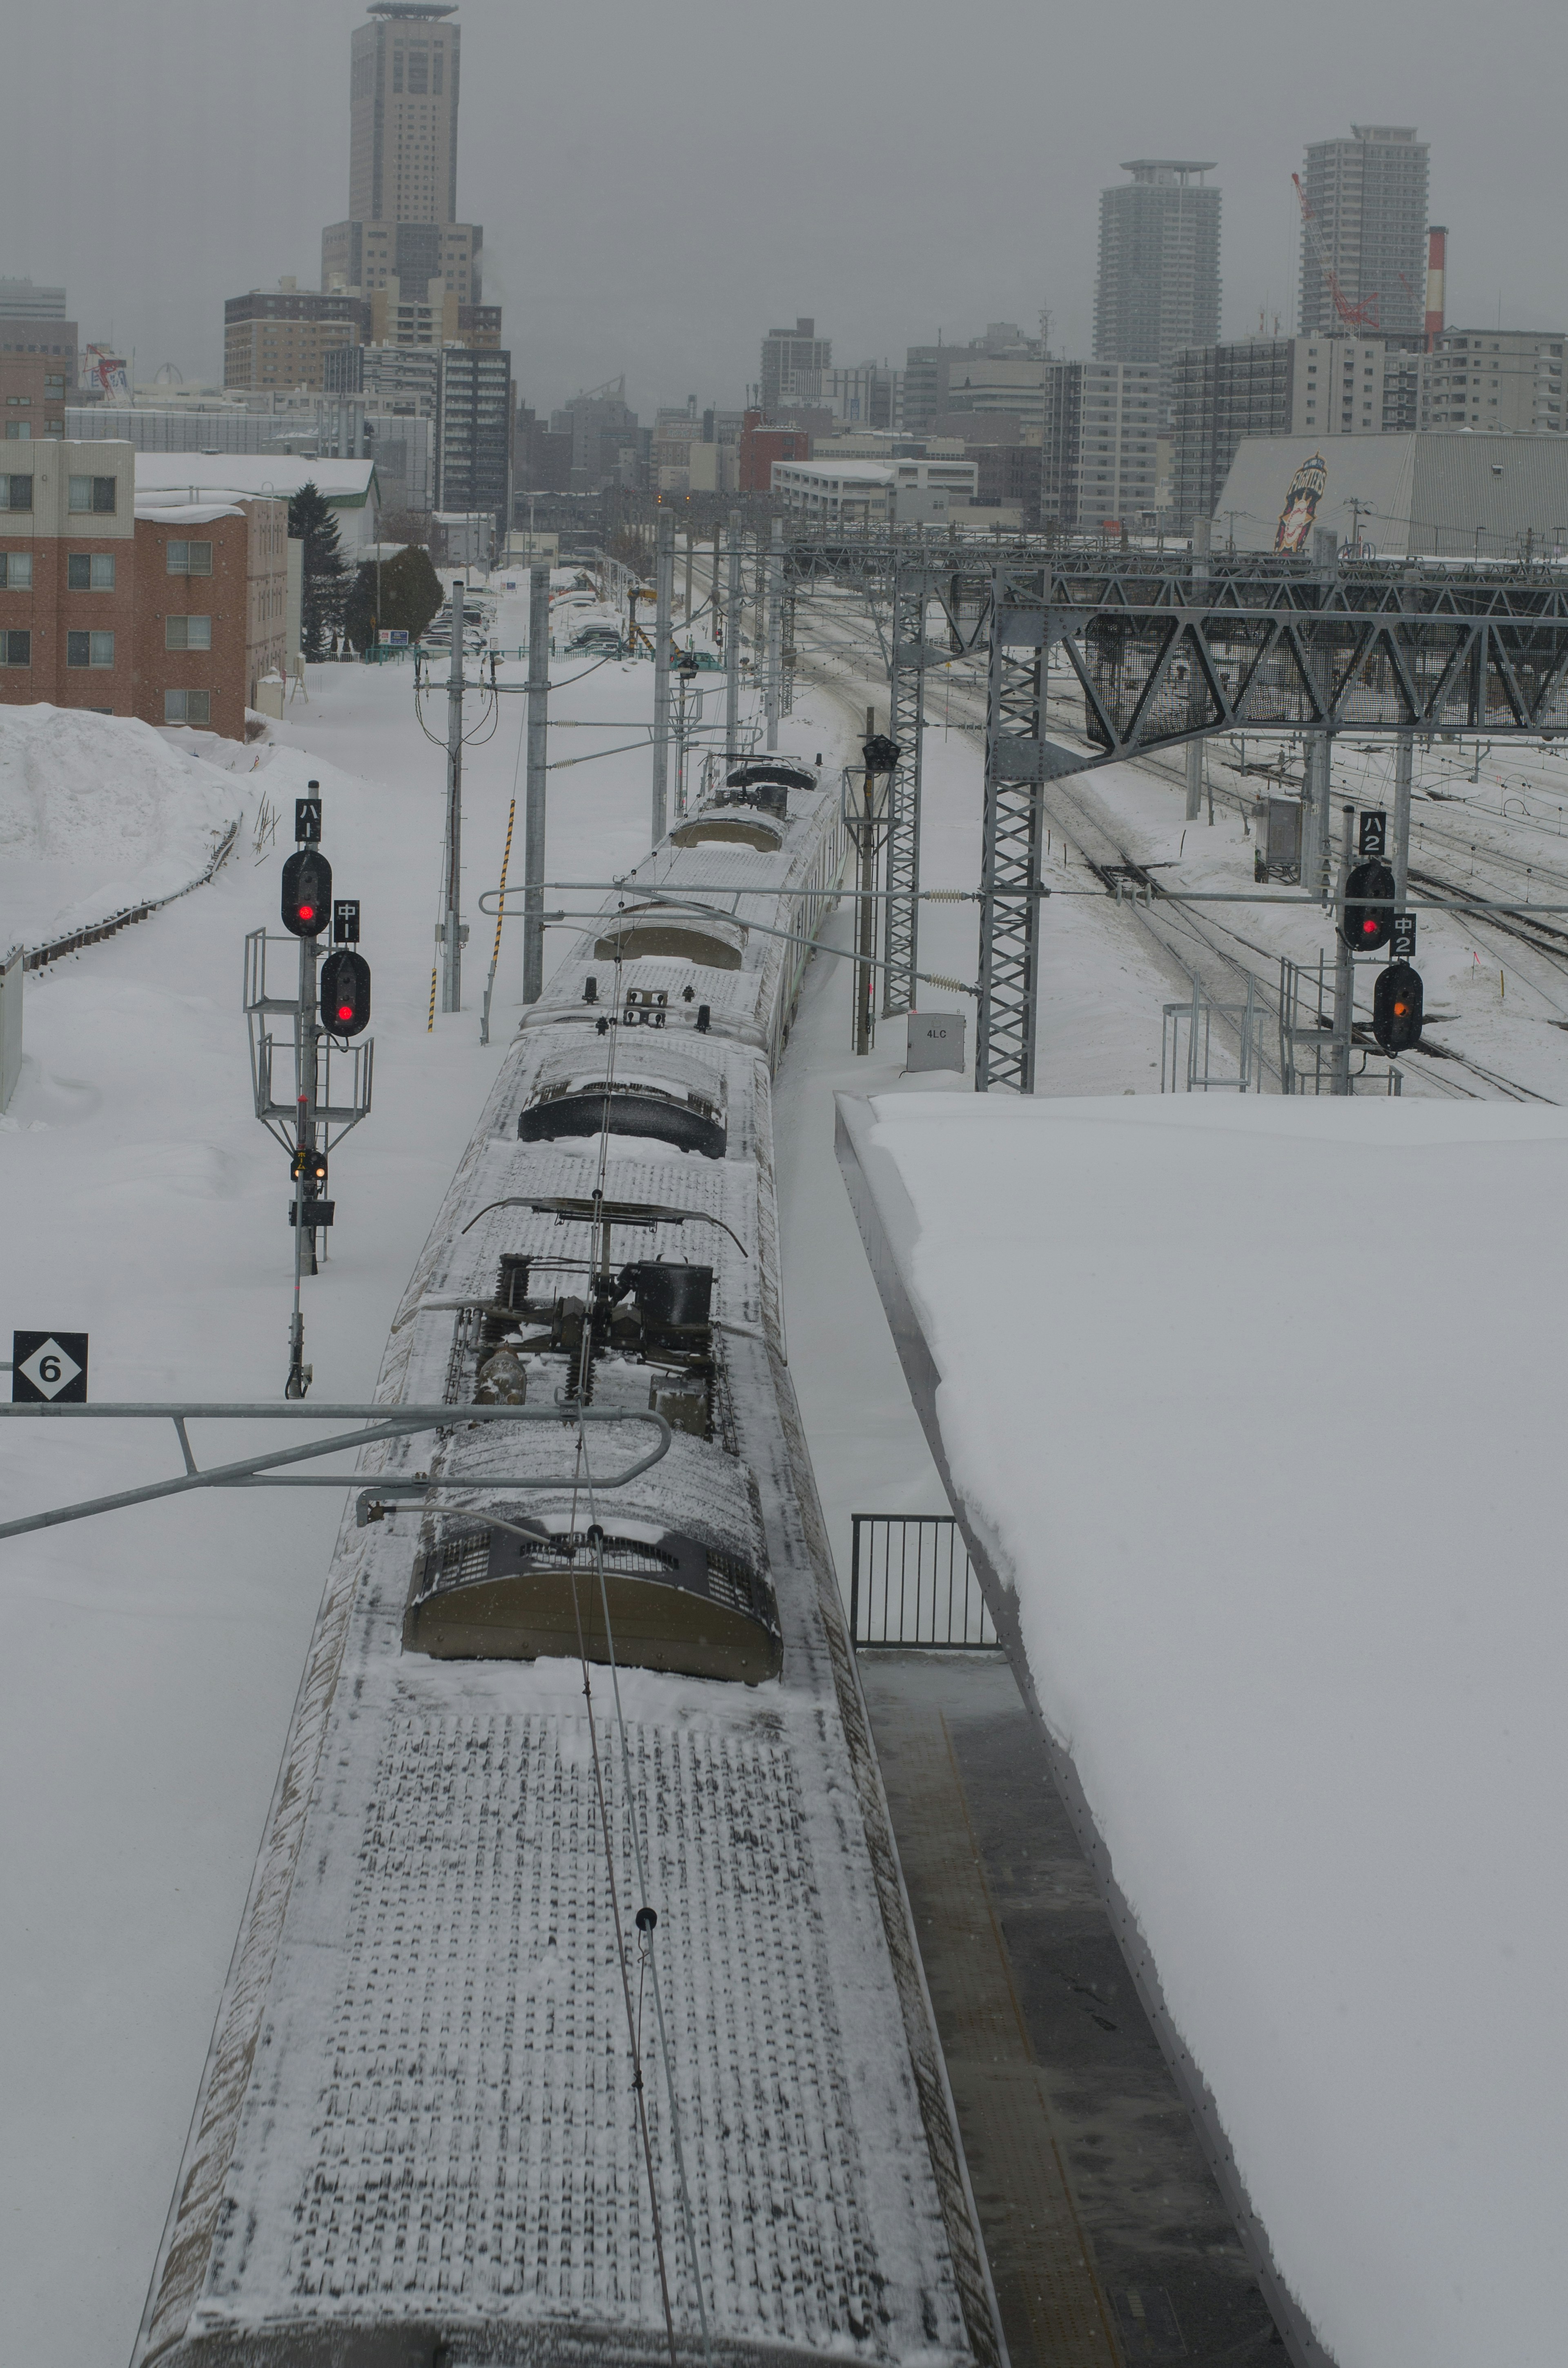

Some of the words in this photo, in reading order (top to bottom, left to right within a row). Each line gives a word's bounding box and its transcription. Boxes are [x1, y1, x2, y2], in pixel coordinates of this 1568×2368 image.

[667, 428, 689, 438] ホテル
[1288, 468, 1326, 495] FIGHTERS
[297, 1152, 305, 1169] ホーム
[40, 1356, 61, 1382] 6
